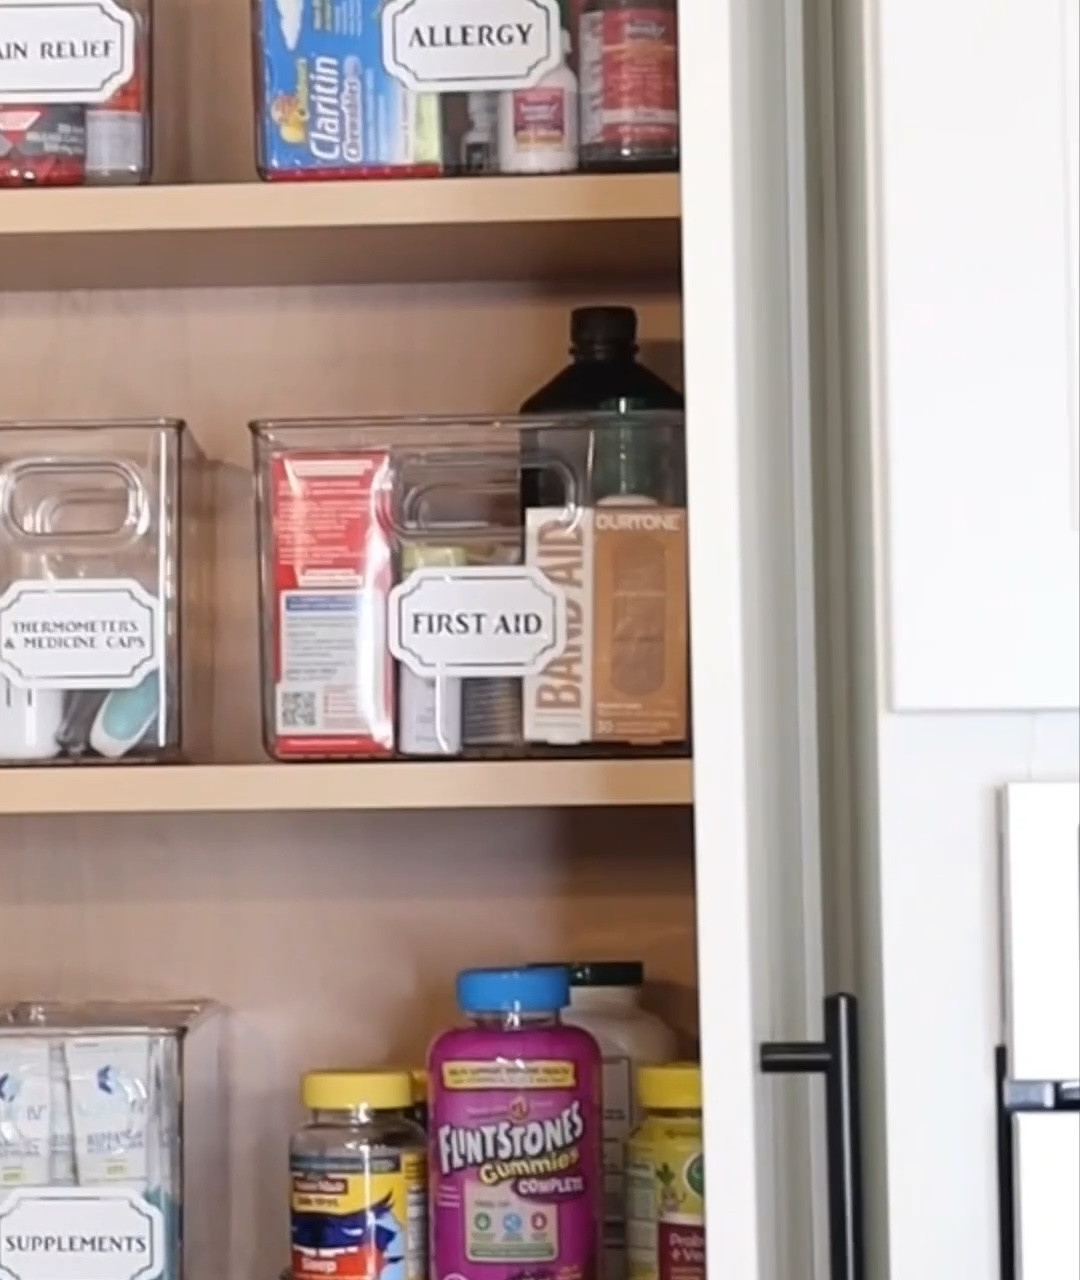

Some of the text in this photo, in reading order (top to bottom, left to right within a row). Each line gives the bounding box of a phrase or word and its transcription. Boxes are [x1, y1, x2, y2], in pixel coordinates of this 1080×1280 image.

[408, 22, 533, 48] ALLERGY
[40, 39, 116, 60] RELIEF
[309, 56, 340, 160] Claritin
[11, 620, 139, 634] THERMOMETERS
[410, 612, 543, 636] FIRST AID
[23, 636, 97, 650] MEDICINE
[106, 636, 146, 650] CAPS
[438, 1100, 584, 1175] FLINTSTONES
[480, 1147, 580, 1186] Gummies
[4, 1234, 147, 1254] SUPPLEMENTS
